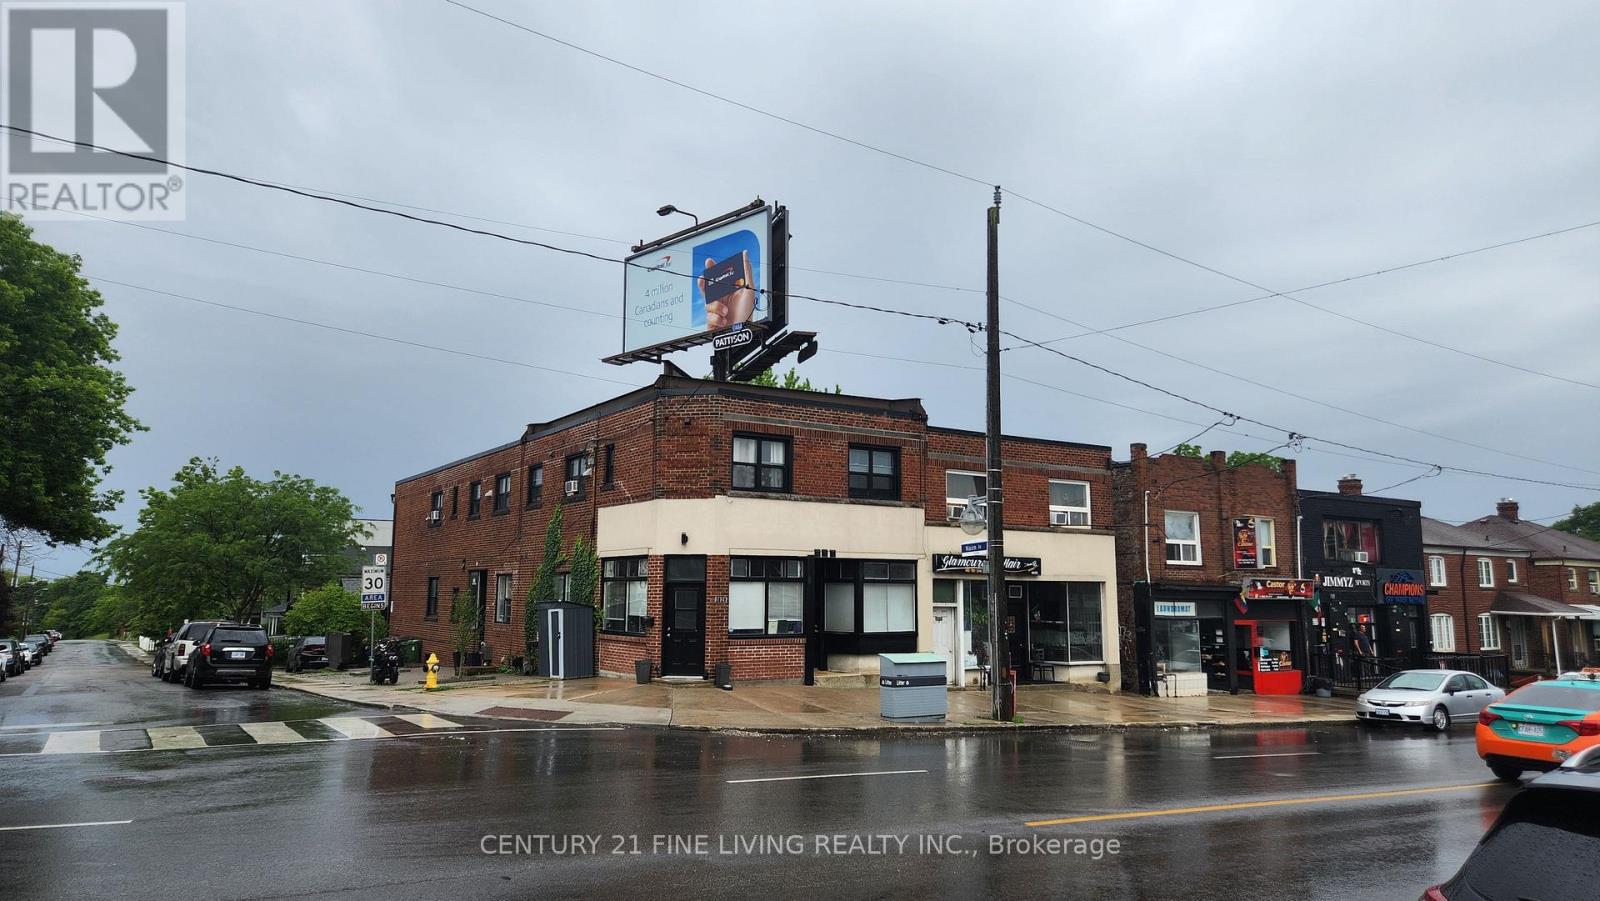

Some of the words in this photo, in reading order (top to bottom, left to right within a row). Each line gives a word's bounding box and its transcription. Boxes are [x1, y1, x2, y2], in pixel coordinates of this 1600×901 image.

[651, 282, 673, 297] million
[634, 299, 669, 316] Canadians
[670, 292, 684, 306] and
[643, 312, 673, 327] counting
[715, 332, 750, 348] PATTISON
[364, 577, 384, 590] 30
[1266, 580, 1285, 588] Castor
[1322, 576, 1354, 588] JIMMYZ
[1384, 583, 1425, 596] CHAMPIONS
